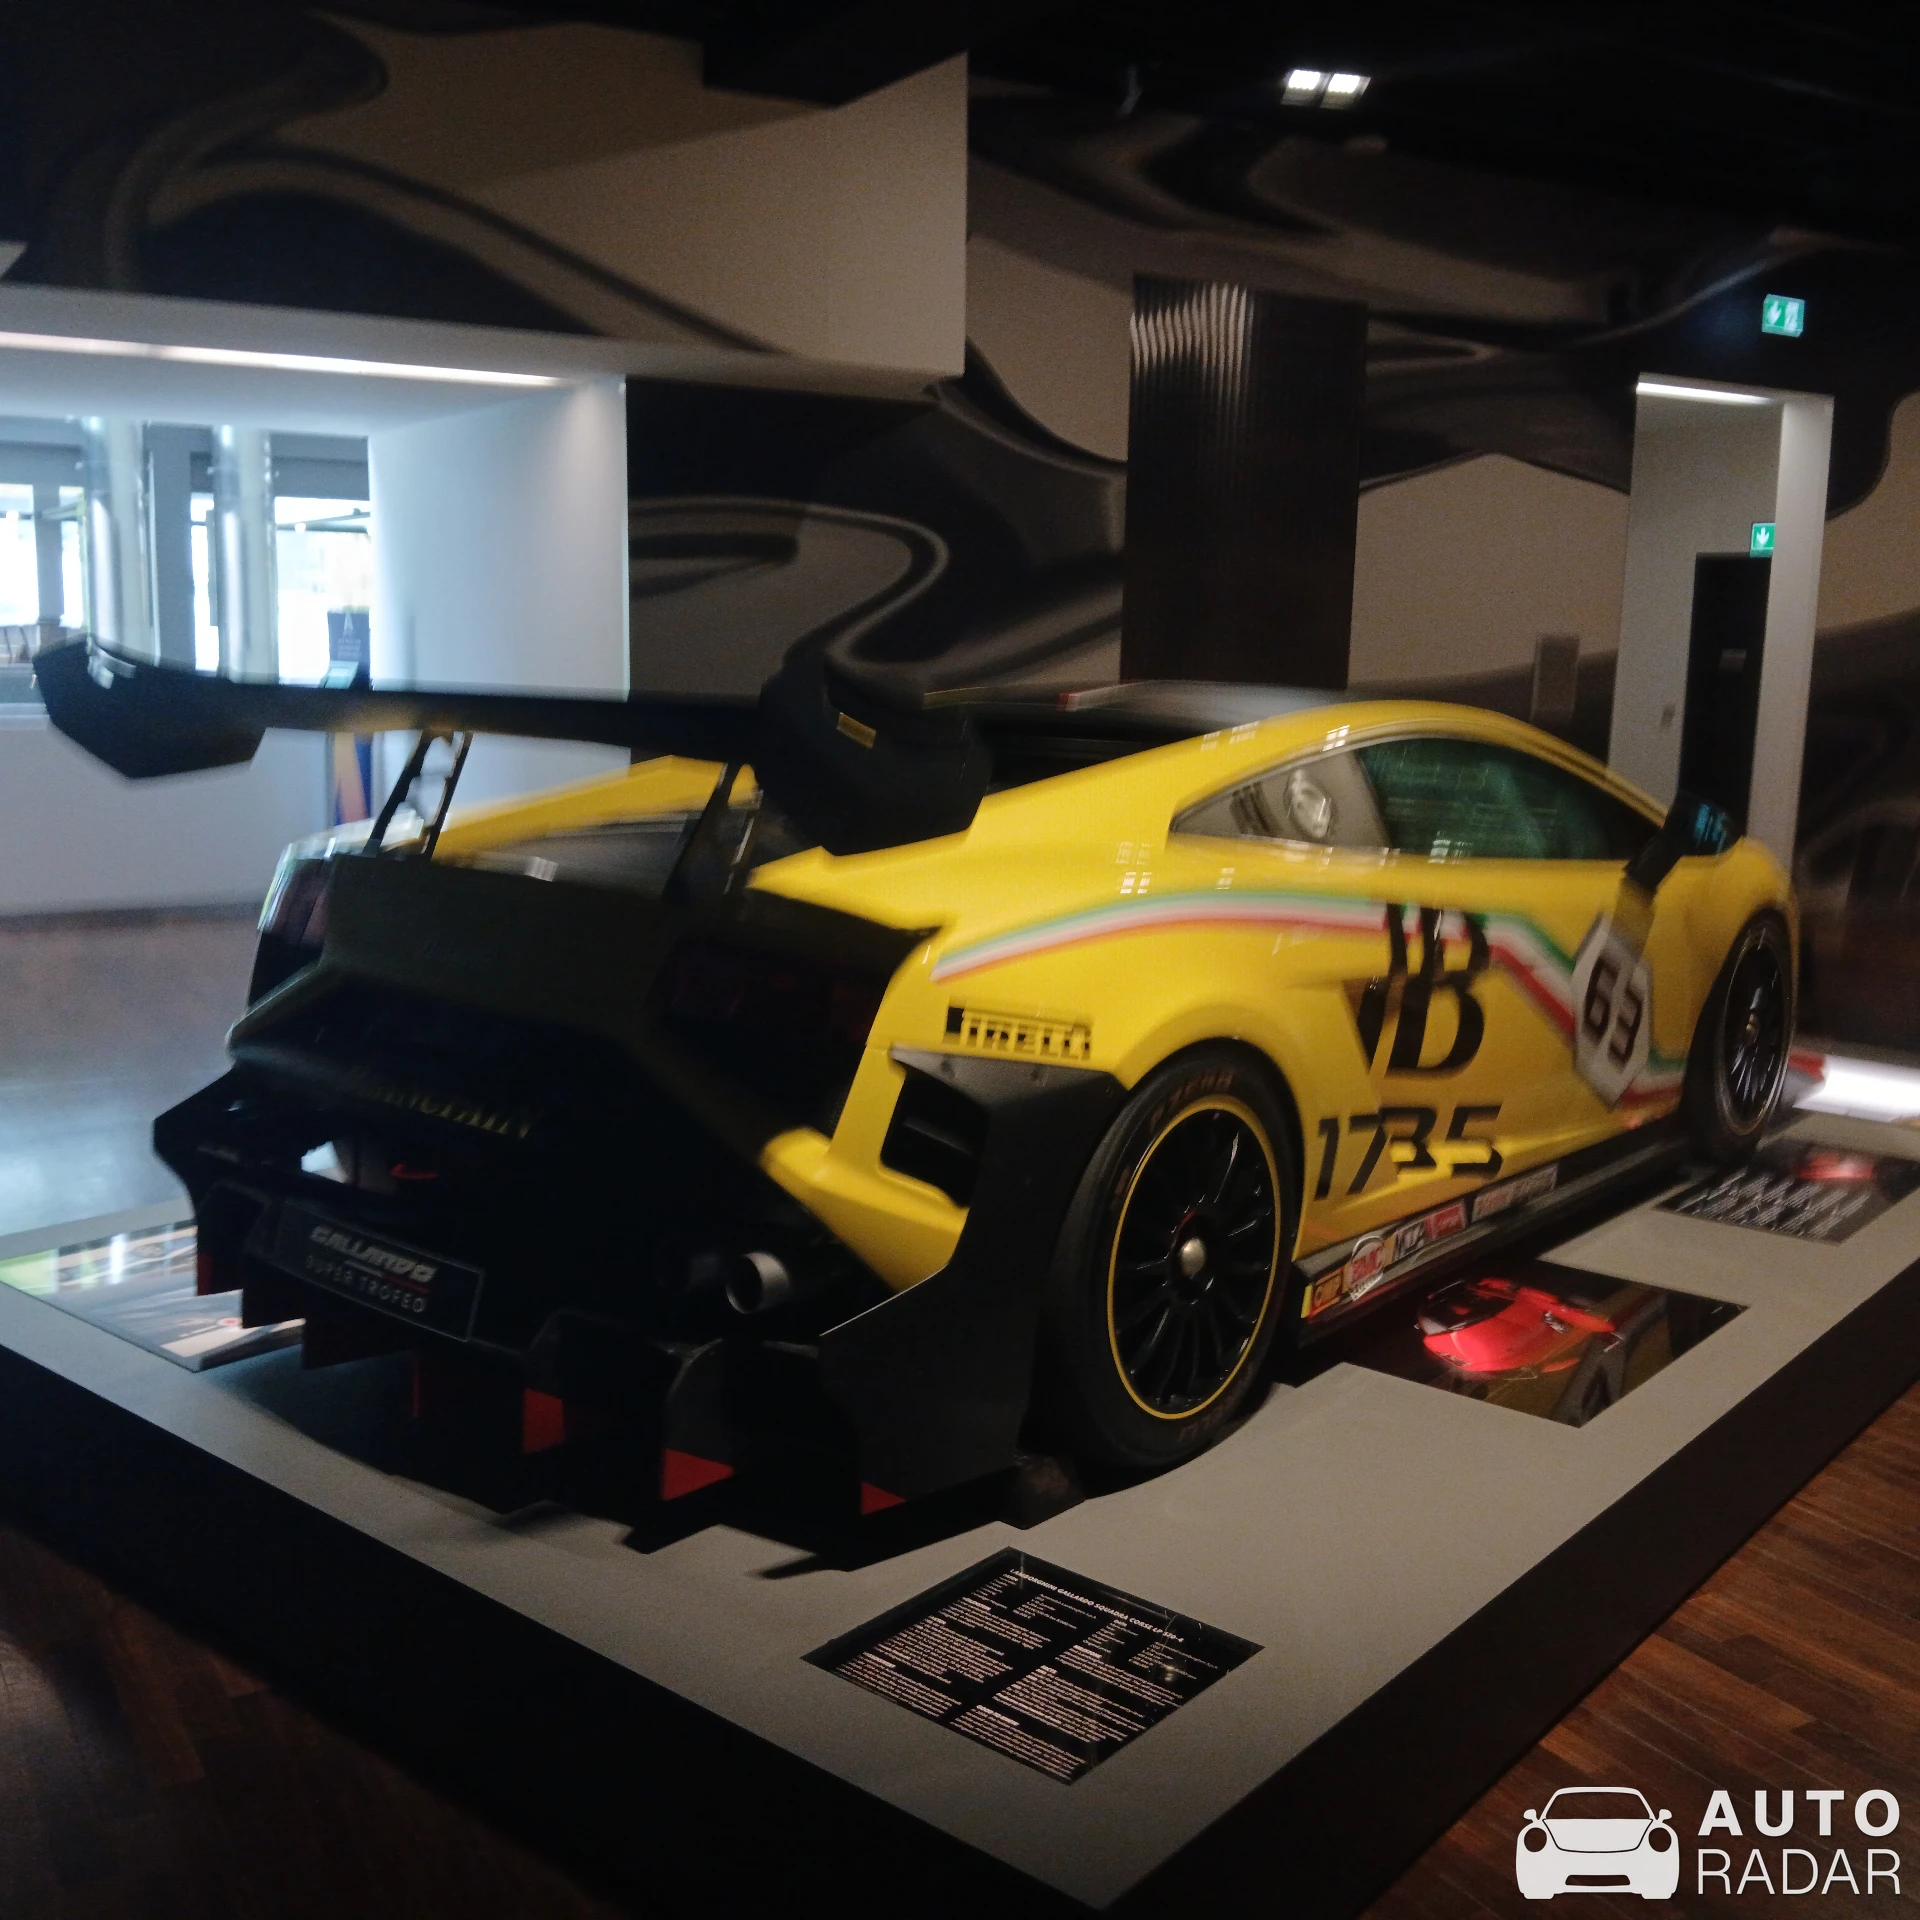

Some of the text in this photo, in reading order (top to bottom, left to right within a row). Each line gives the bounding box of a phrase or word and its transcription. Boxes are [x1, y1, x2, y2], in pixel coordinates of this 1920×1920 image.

[943, 1003, 1093, 1060] PIRELLI
[1584, 950, 1646, 1065] 63
[1313, 1103, 1504, 1200] 1735
[357, 1273, 427, 1313] TROFEO
[1009, 1568, 1059, 1590] LAMBORGHINI
[1056, 1587, 1096, 1606] GALLARDO
[1092, 1603, 1131, 1621] SQUADRA
[1128, 1617, 1155, 1630] CORSE
